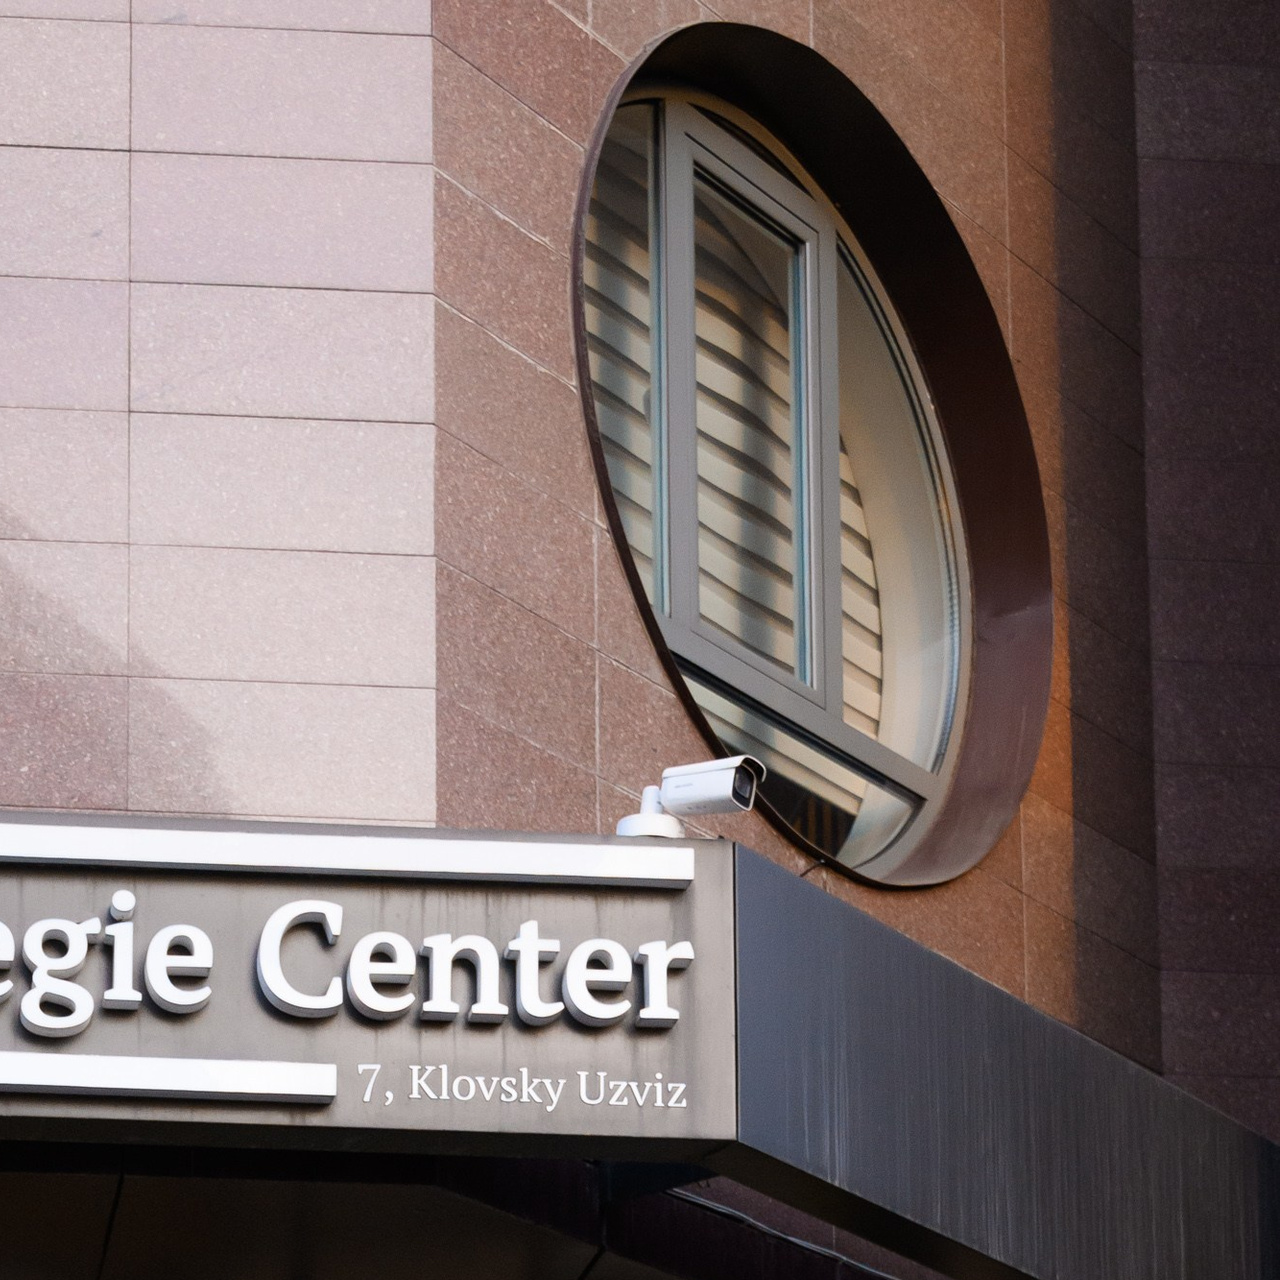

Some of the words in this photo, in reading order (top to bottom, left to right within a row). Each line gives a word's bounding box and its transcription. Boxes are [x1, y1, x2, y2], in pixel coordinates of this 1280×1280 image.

[256, 899, 696, 1028] Center
[357, 1064, 394, 1106] 7,
[408, 1064, 567, 1112] Klovsky
[576, 1070, 687, 1107] Uzviz
